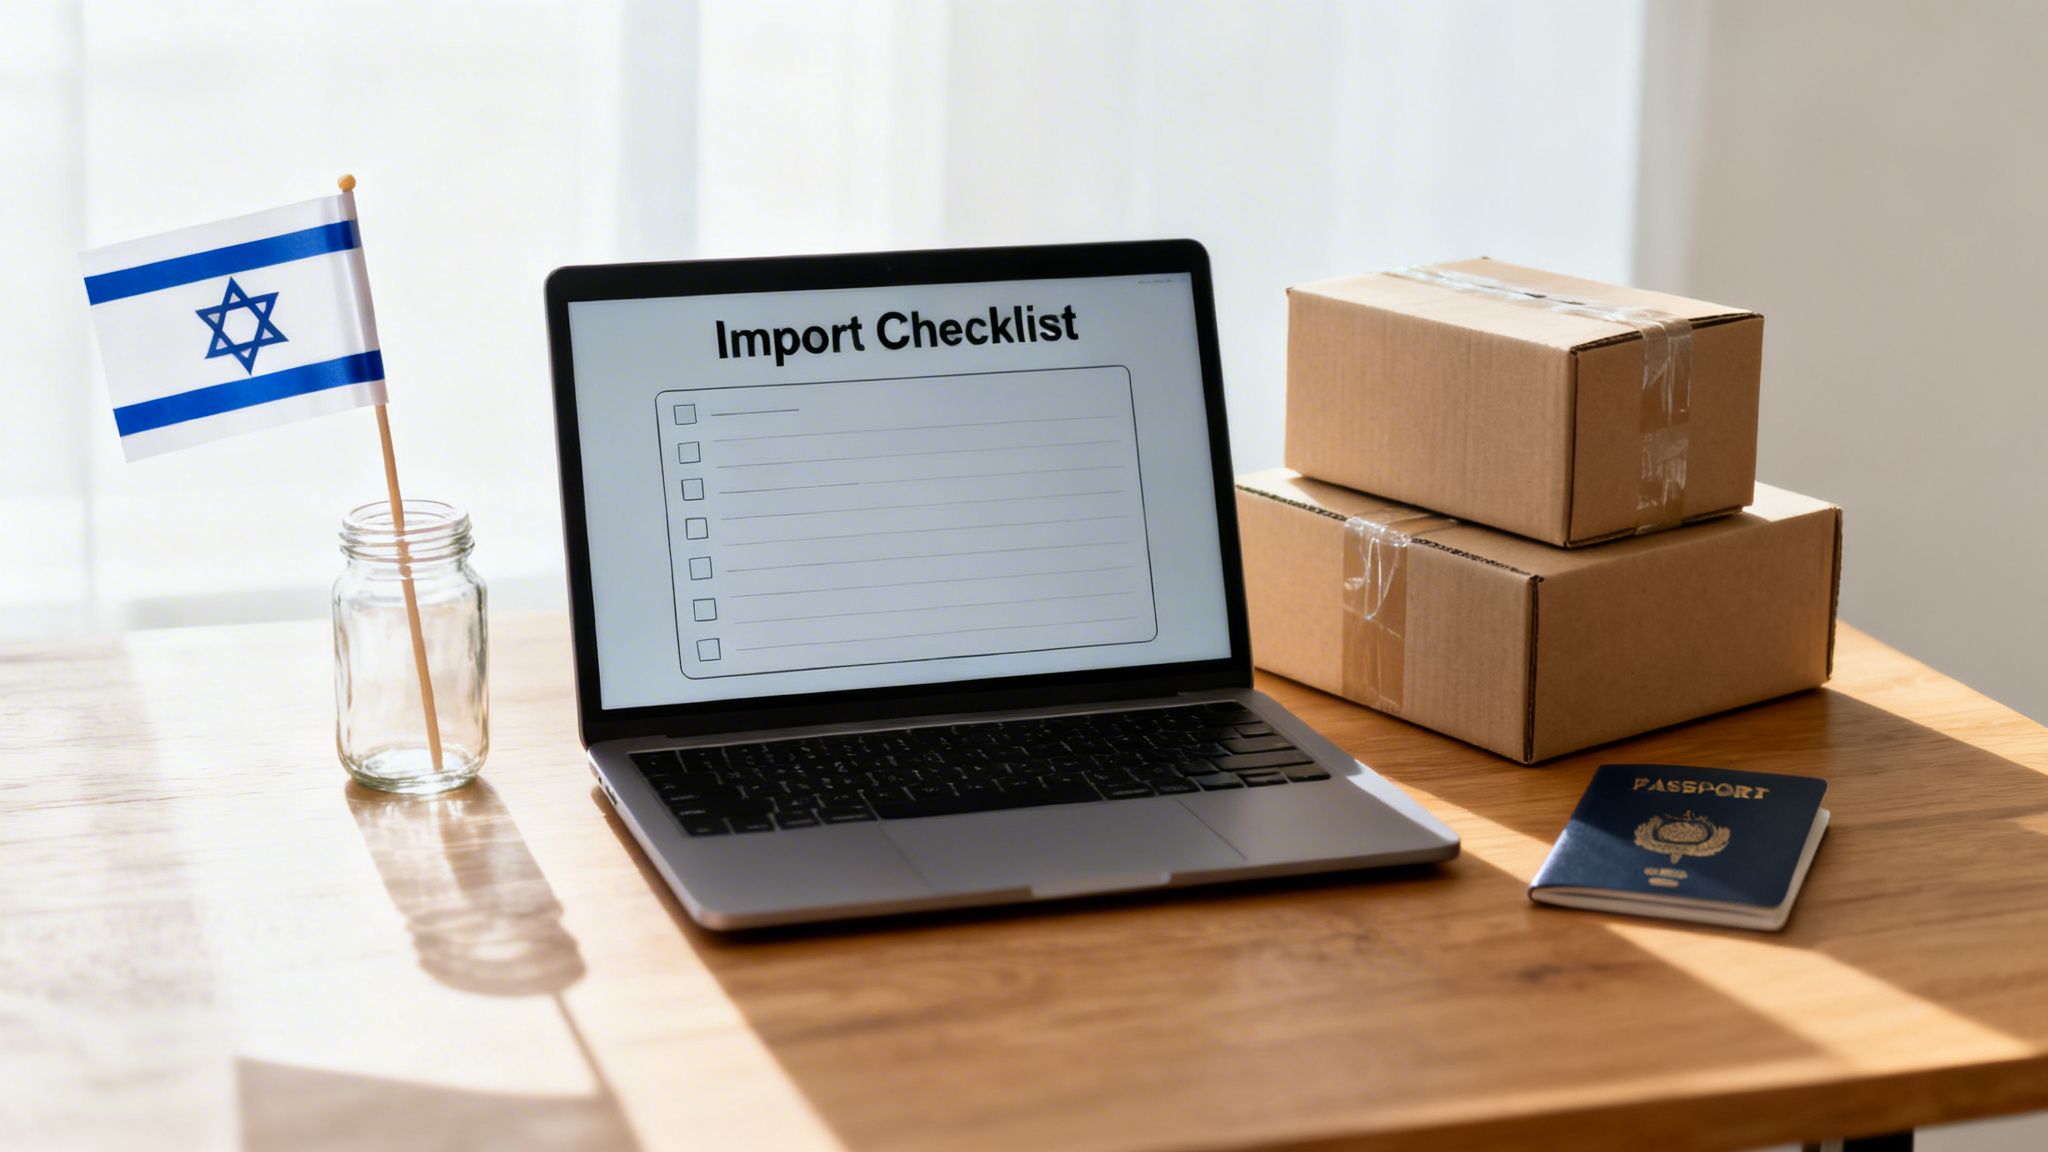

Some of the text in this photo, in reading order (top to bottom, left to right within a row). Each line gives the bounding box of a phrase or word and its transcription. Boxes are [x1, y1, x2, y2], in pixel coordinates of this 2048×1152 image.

[716, 305, 1079, 367] Import Checklist
[1633, 778, 1770, 800] PASSPORT
